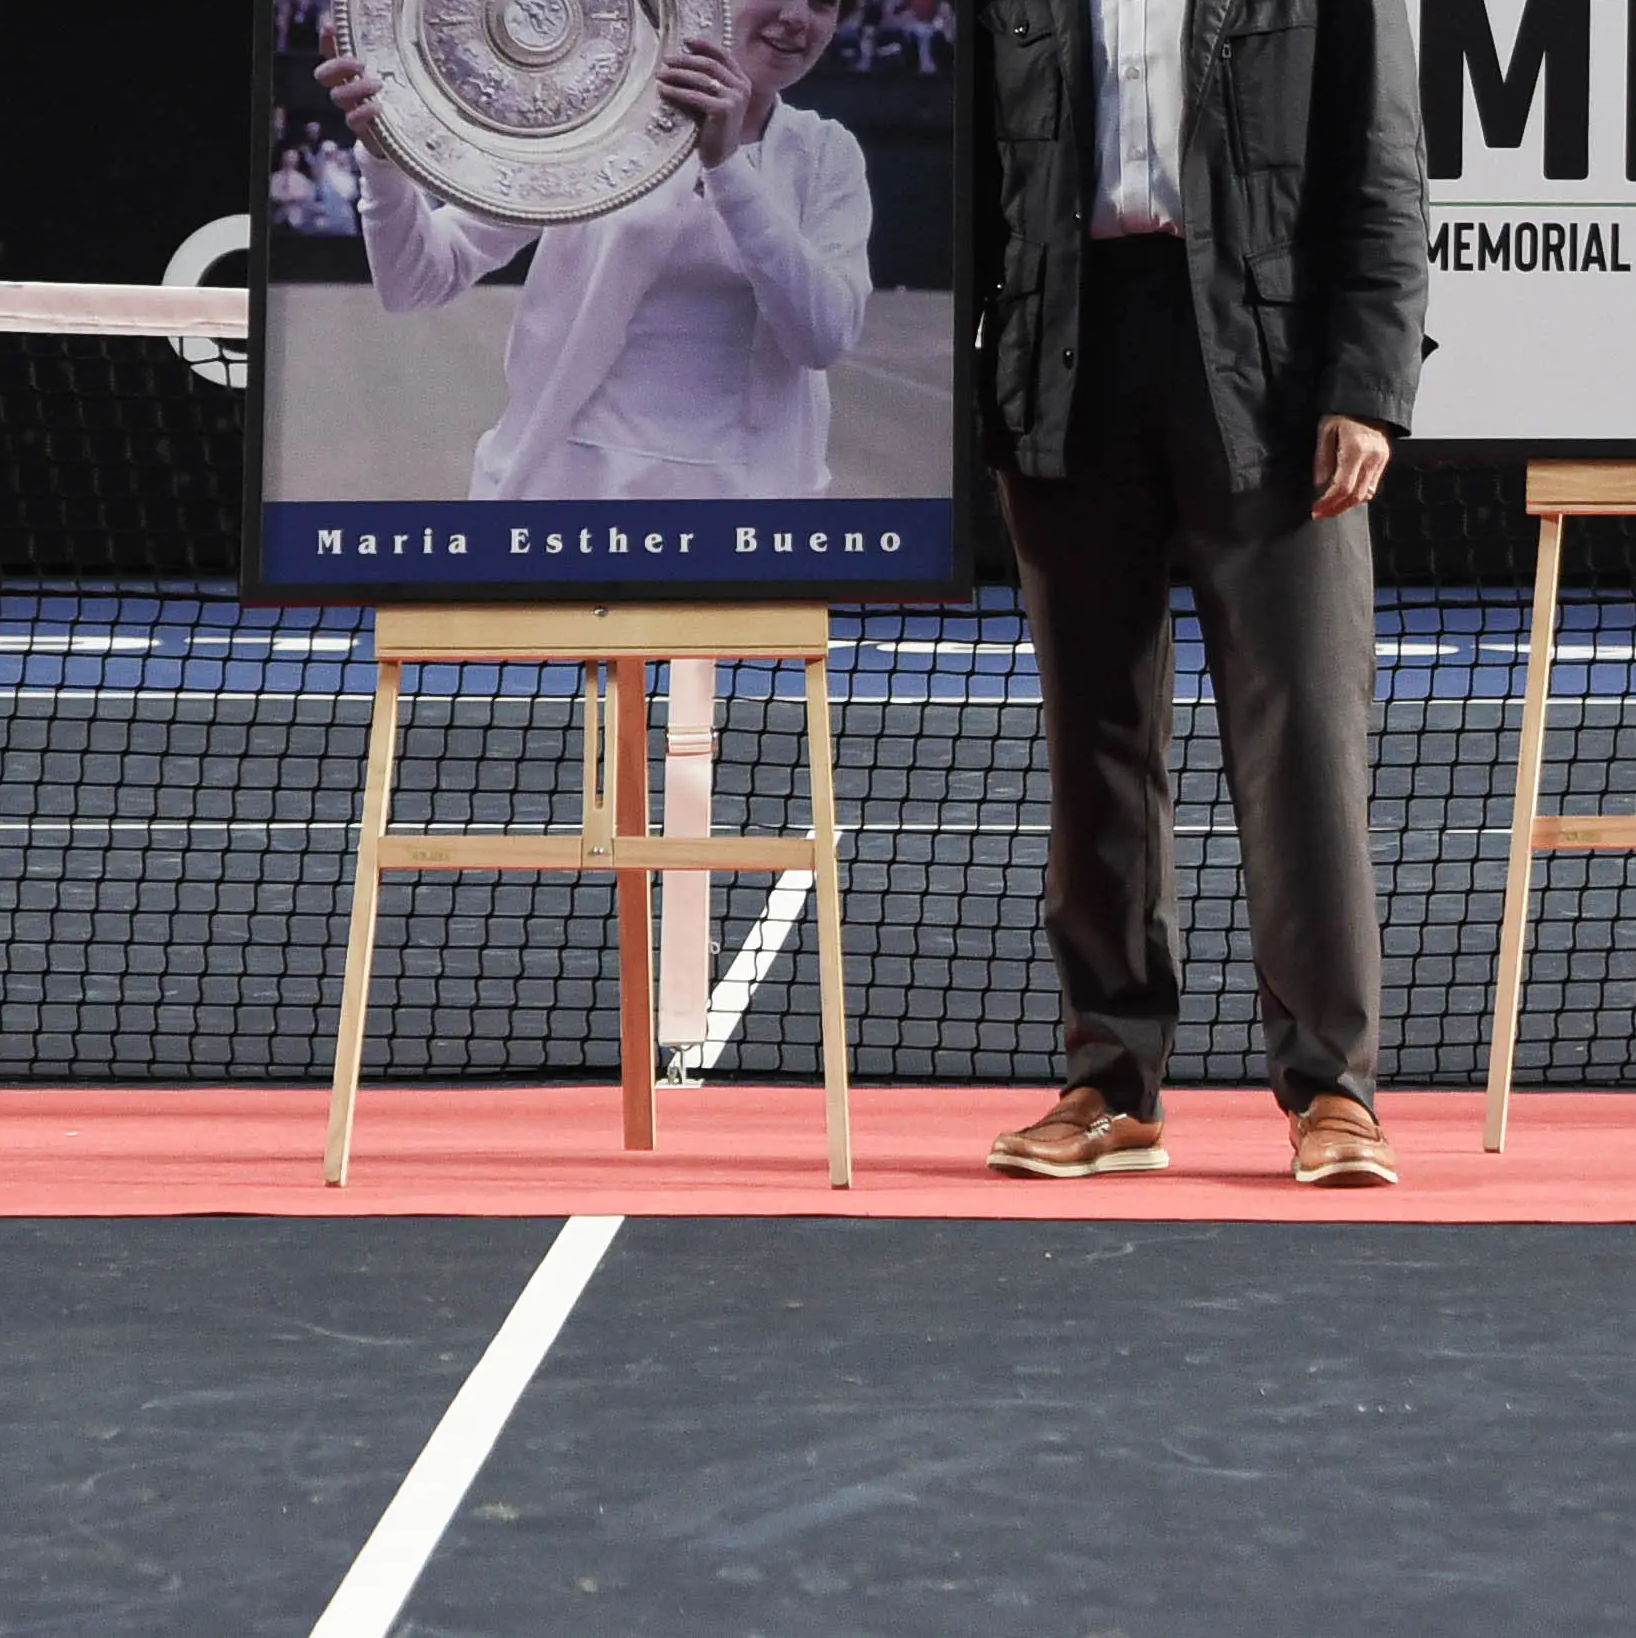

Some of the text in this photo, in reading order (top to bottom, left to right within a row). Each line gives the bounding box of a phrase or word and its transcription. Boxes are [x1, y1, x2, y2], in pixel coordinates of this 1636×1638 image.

[1426, 221, 1631, 274] MEMORIAL
[317, 526, 901, 555] Maria Esther Bueno
